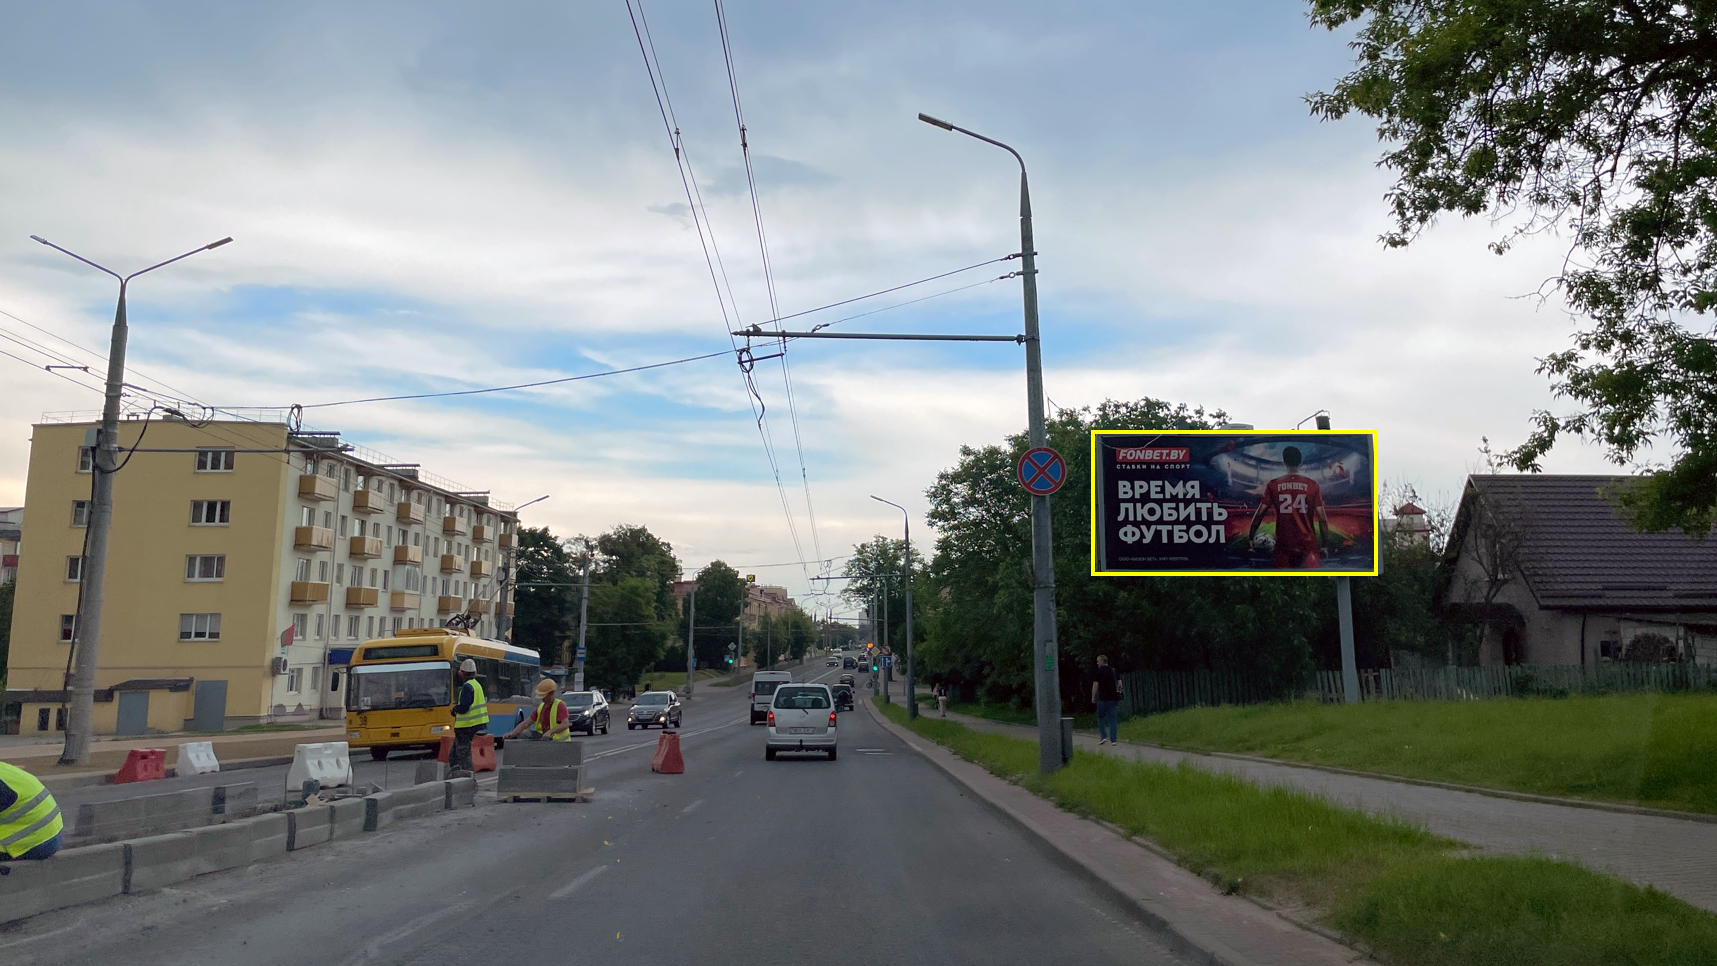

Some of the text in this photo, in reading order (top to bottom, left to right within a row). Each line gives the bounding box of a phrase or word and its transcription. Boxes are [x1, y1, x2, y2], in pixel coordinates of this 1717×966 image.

[1118, 449, 1186, 460] FONBET.BY
[1118, 480, 1201, 499] ВРЕМЯ
[1277, 481, 1309, 491] FONBET
[1117, 502, 1228, 521] ЛЮБИТЬ
[1278, 493, 1308, 514] 24
[1118, 524, 1226, 544] ФУТБОЛ
